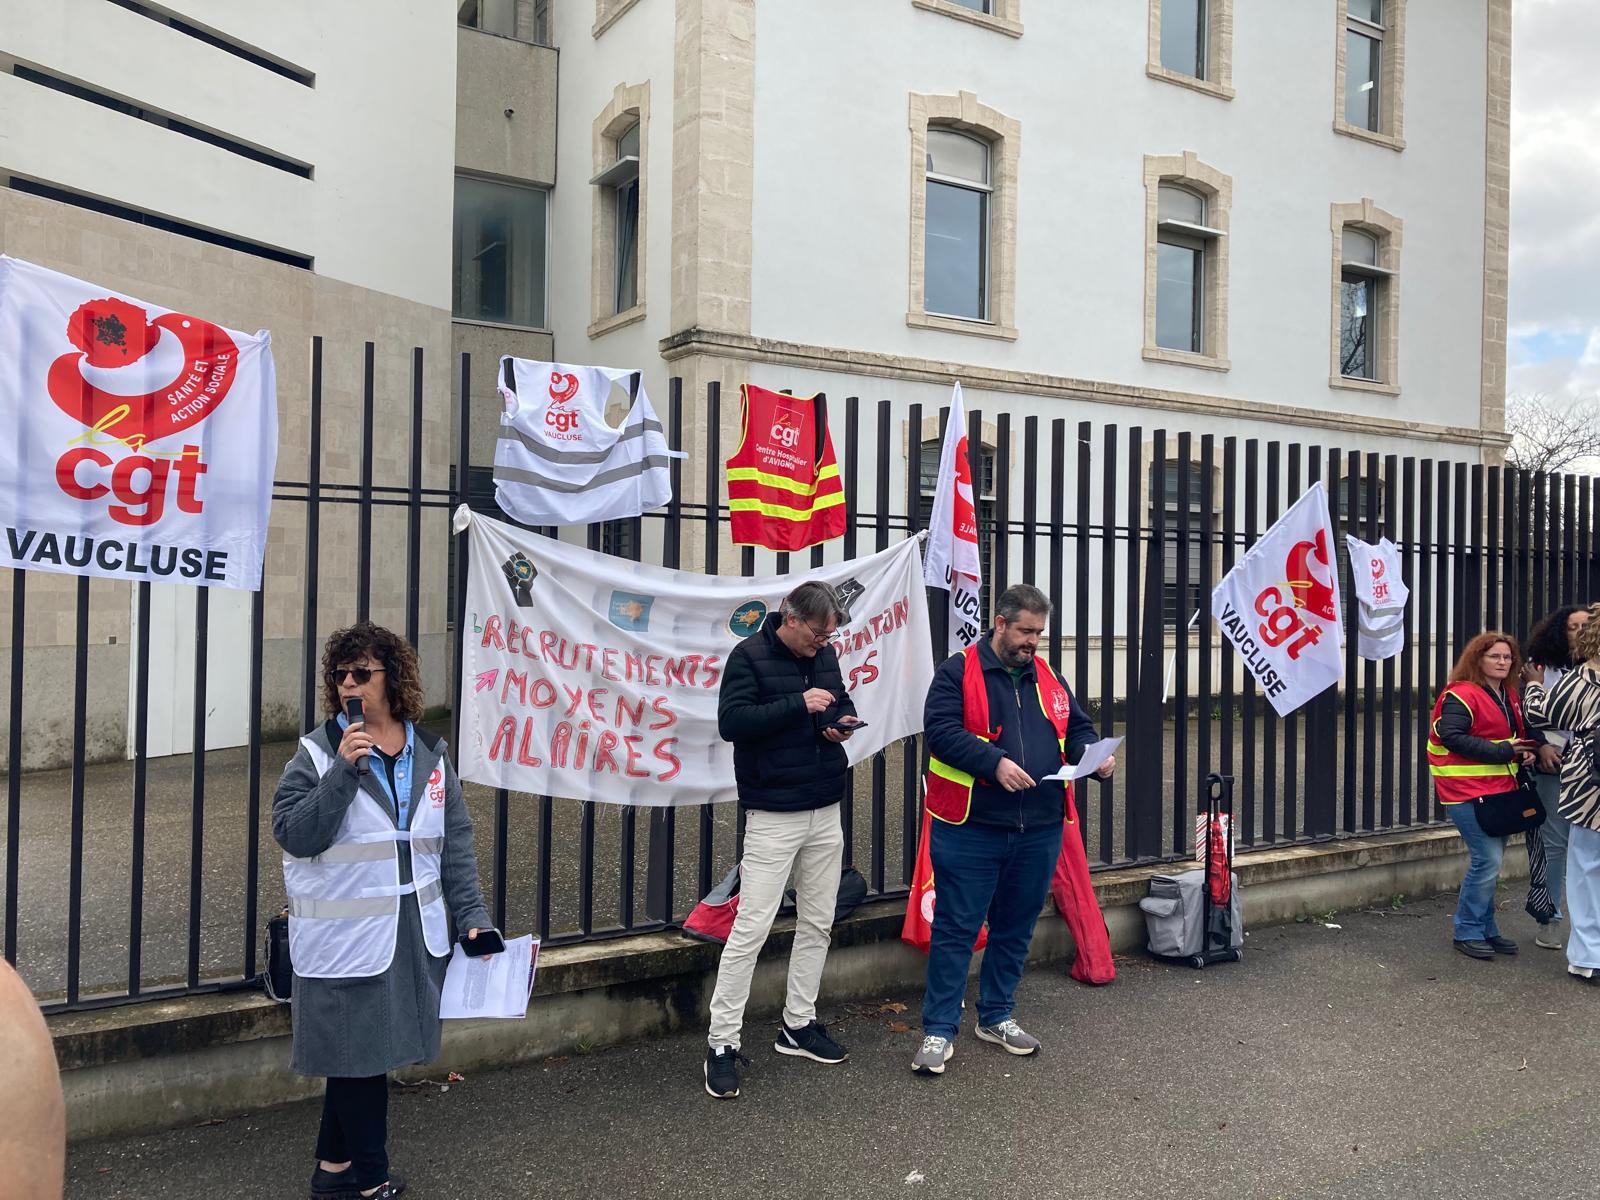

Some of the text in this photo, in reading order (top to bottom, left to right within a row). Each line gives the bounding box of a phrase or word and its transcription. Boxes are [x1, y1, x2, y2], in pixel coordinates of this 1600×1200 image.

[167, 359, 209, 406] SANTÉ ET
[170, 353, 231, 424] ACTION SOCIALE
[543, 429, 583, 441] VAUCLUSE
[545, 410, 579, 433] cgt
[770, 424, 801, 447] cgt
[755, 443, 777, 456] Centre
[55, 444, 208, 526] cgt
[6, 527, 229, 581] VAUCLUSE
[1220, 602, 1287, 698] VAUCLUSE
[1254, 586, 1324, 661] cgt
[480, 613, 721, 689] RECRUTEMENTS
[500, 668, 678, 731] MOYENS
[429, 789, 445, 803] cg
